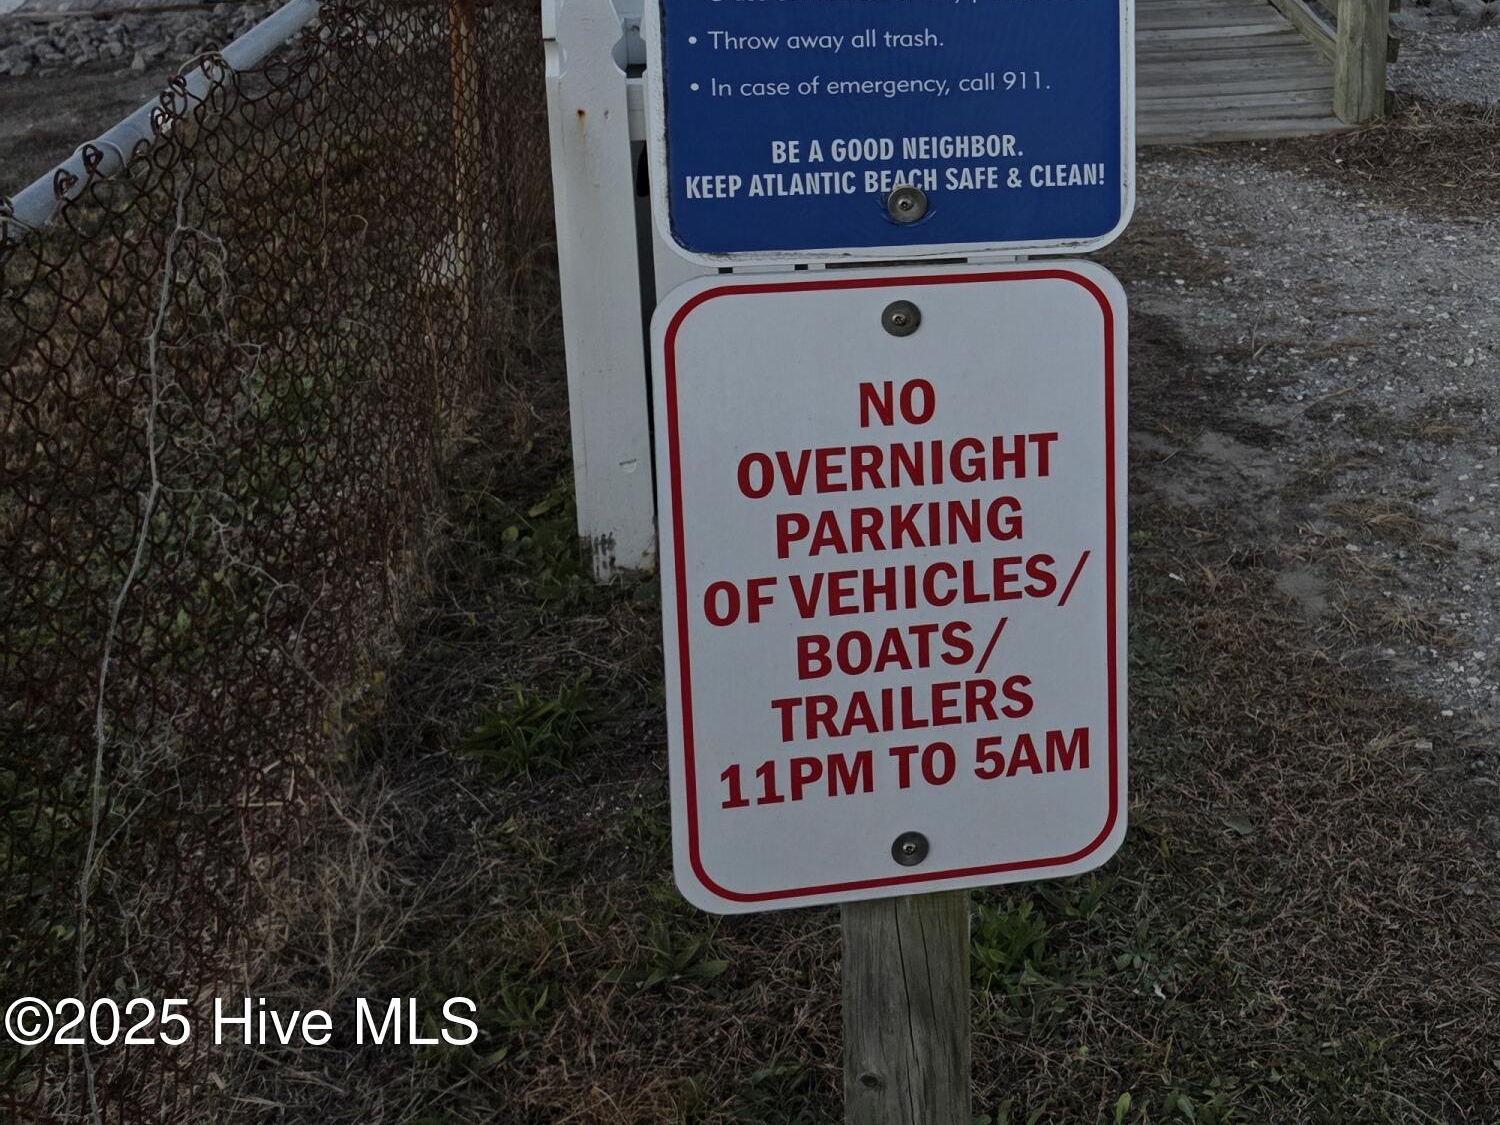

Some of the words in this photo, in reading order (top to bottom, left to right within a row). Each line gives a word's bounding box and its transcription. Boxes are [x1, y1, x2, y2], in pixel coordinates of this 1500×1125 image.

[708, 31, 779, 50] Throw
[787, 35, 844, 52] away
[851, 30, 876, 48] all
[883, 28, 944, 47] trash.
[711, 79, 732, 96] In
[739, 80, 790, 96] case
[798, 76, 820, 95] of
[826, 77, 950, 99] emergency,
[958, 73, 995, 92] call
[1003, 72, 1050, 90] 911.
[771, 141, 800, 163] BE
[808, 140, 824, 162] A
[831, 138, 894, 162] GOOD
[902, 135, 1023, 159] NEIGHBOR.
[685, 175, 740, 199] KEEP
[748, 172, 856, 197] ATLANTIC
[864, 169, 938, 193] BEACH
[945, 167, 997, 190] SAFE
[1006, 167, 1022, 188] &
[1030, 164, 1105, 186] CLEAN!
[858, 379, 936, 428] NO
[736, 432, 1058, 500] OVERNIGHT
[776, 496, 1023, 559] PARKING
[703, 577, 777, 627] OF
[789, 551, 1090, 619] VEHICLES/
[797, 618, 1008, 680] BOATS/
[771, 675, 1034, 742] TRAILERS
[719, 750, 873, 809] 11PM
[889, 742, 957, 789] TO
[974, 728, 1090, 780] 5AM
